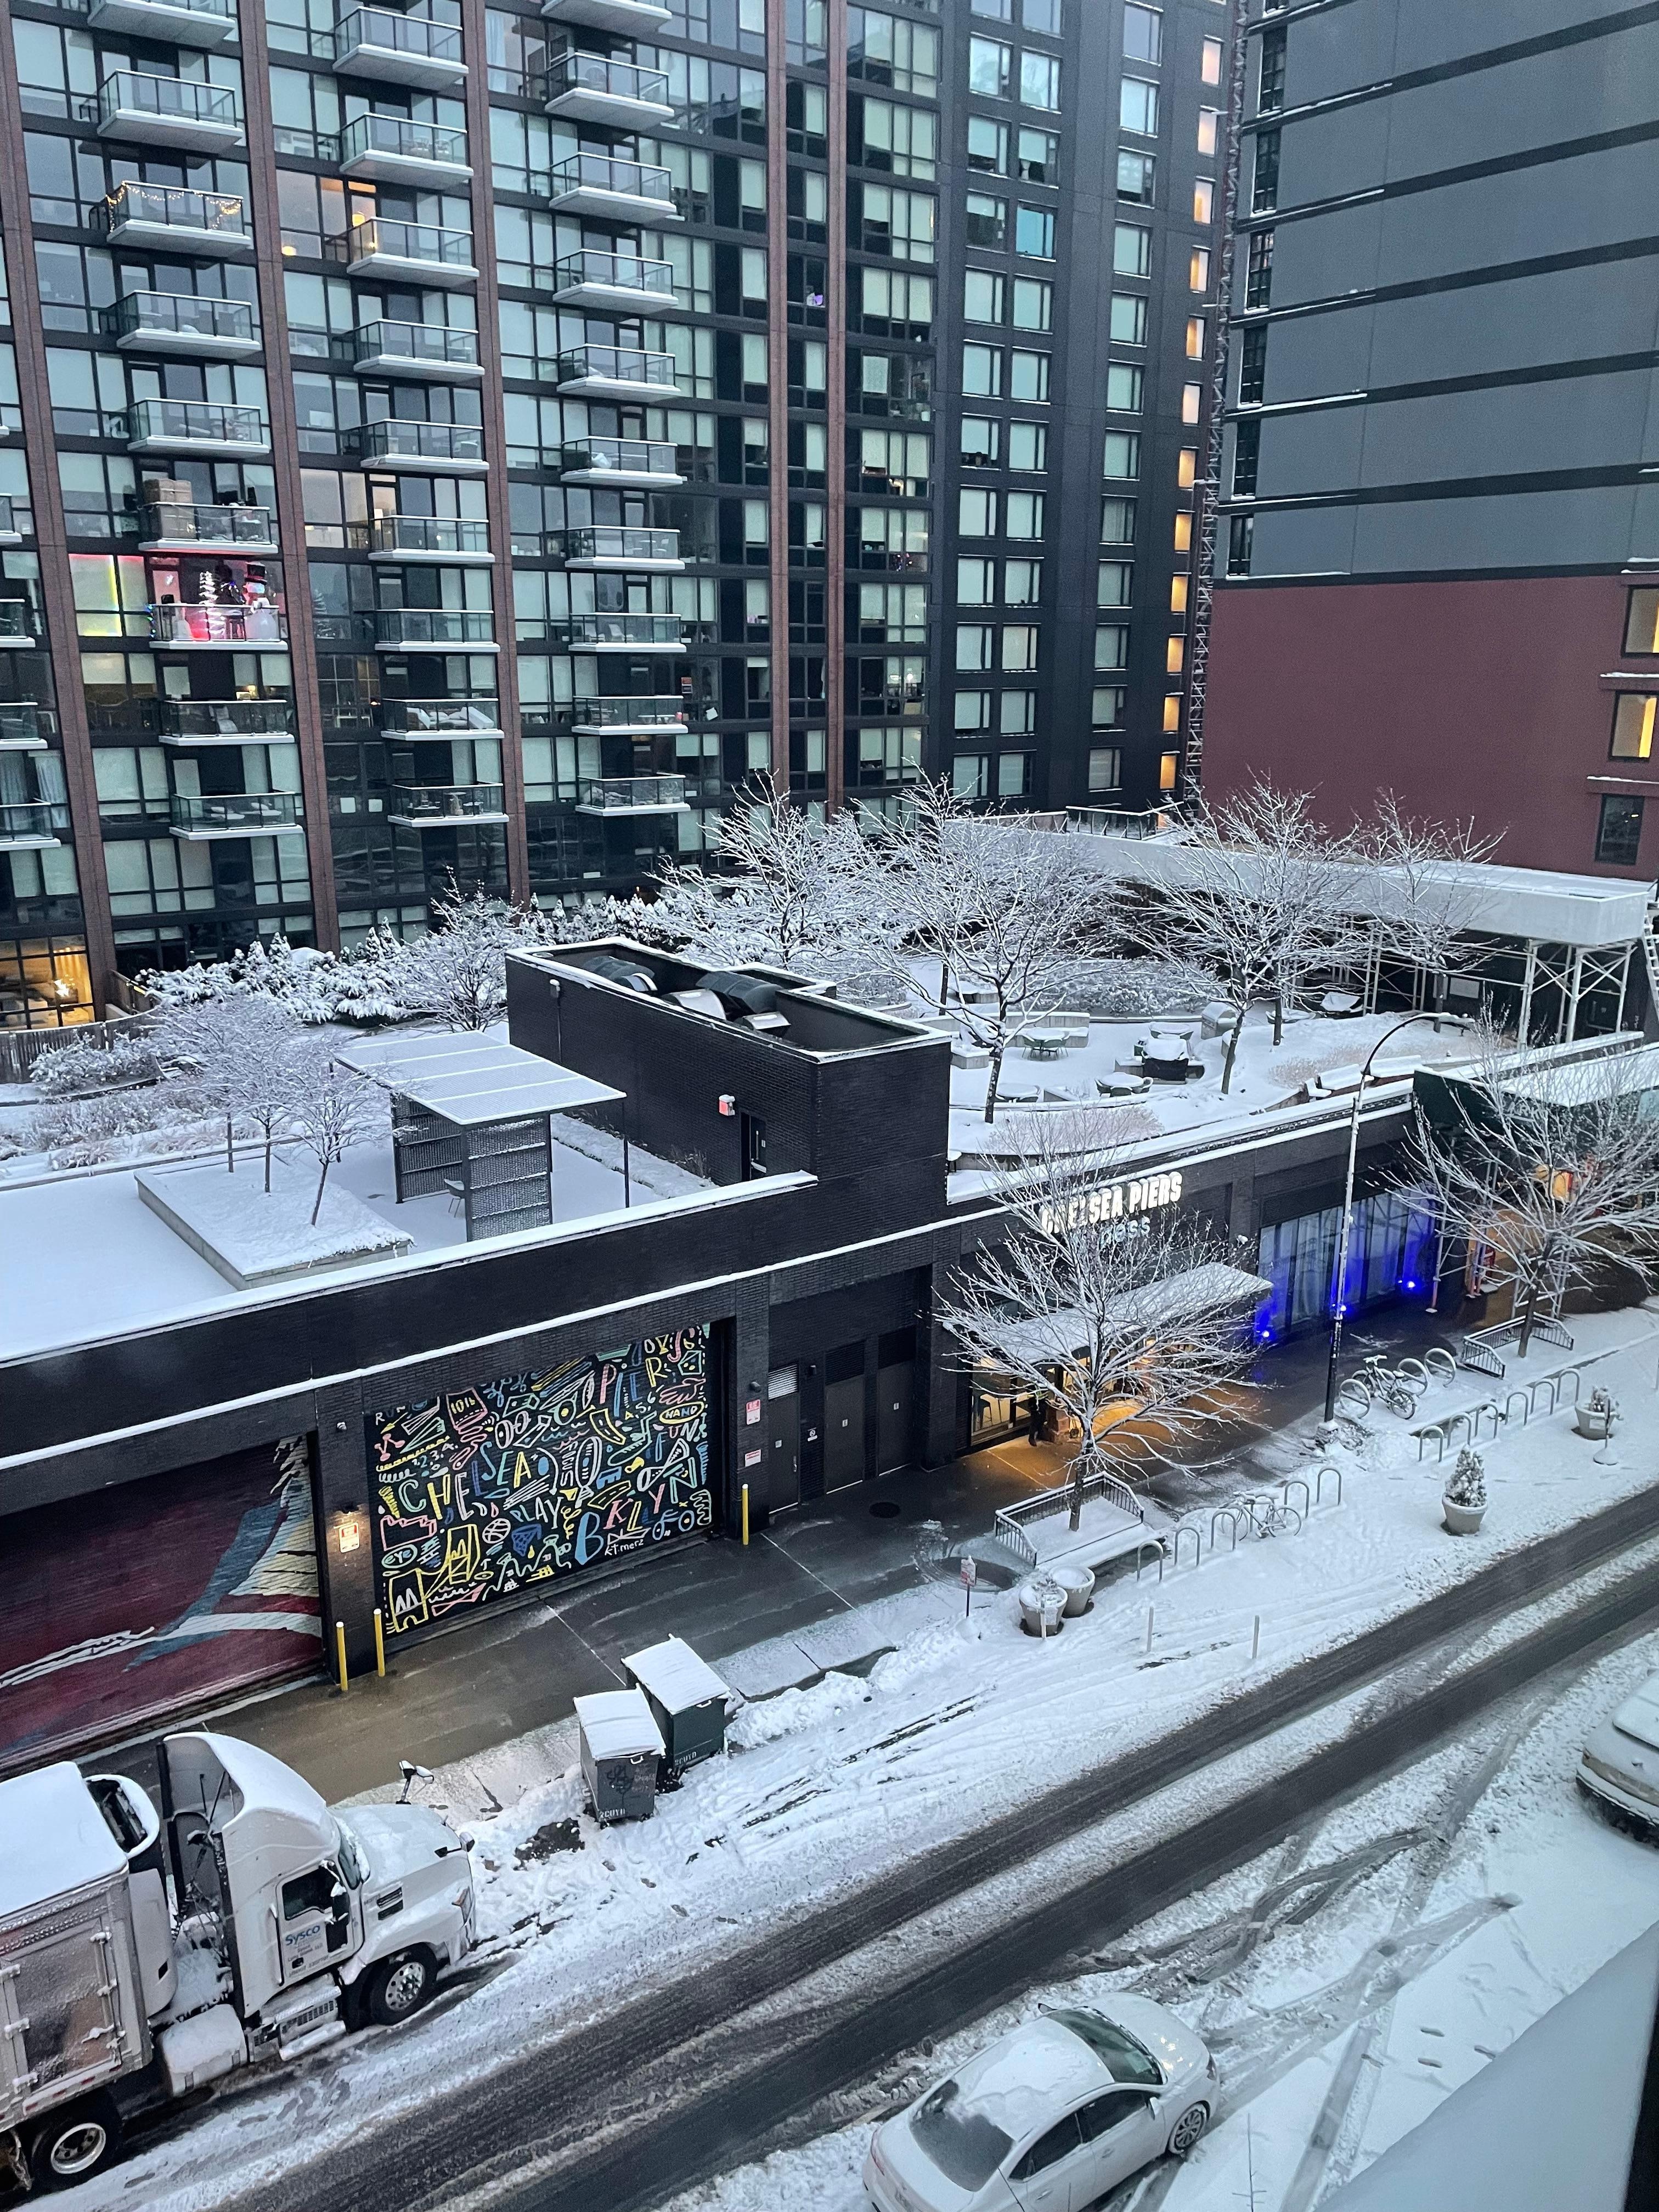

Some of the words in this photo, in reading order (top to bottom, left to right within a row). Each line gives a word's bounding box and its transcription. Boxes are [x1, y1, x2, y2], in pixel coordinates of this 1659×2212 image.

[1128, 1171, 1183, 1214] PIERS
[665, 1406, 698, 1419] HAND
[399, 1441, 532, 1521] CHELSEA
[510, 1497, 564, 1529] PLAY
